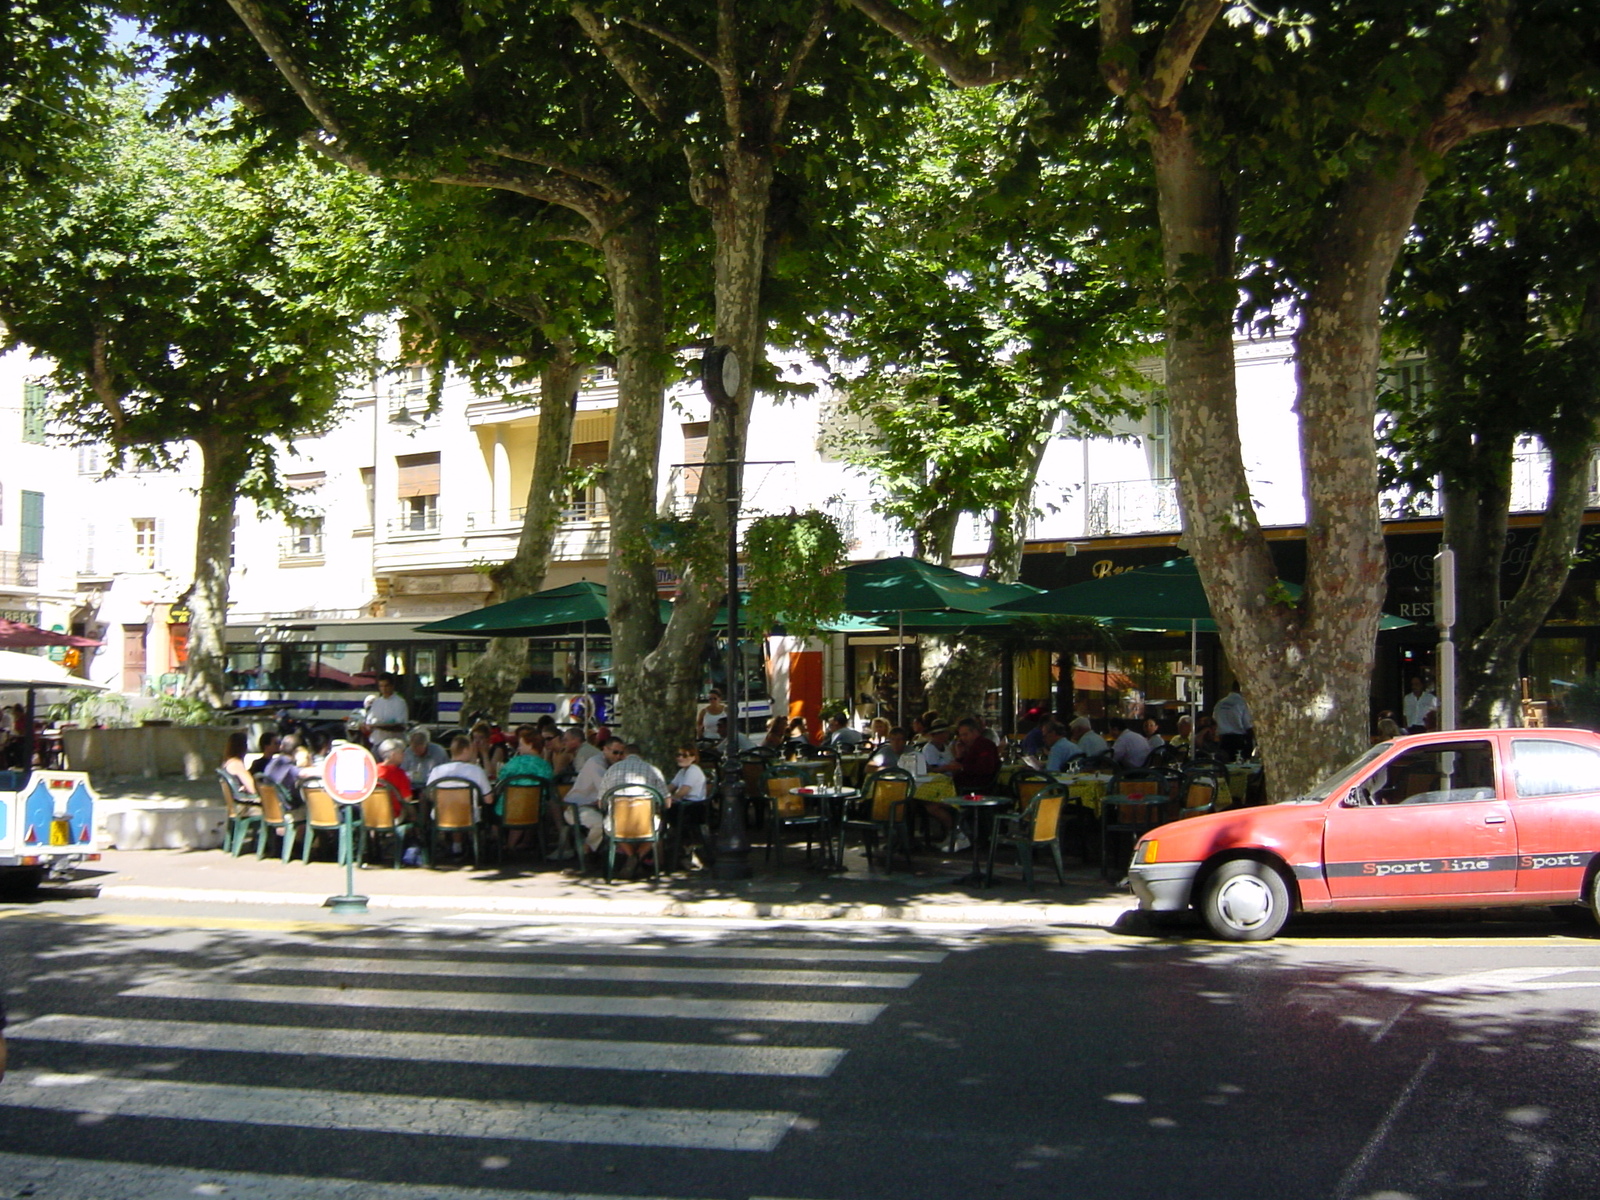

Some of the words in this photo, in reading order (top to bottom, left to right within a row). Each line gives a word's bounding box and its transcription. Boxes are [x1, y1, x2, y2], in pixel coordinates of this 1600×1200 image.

[1363, 861, 1432, 876] Sport
[1441, 859, 1490, 872] line
[1521, 853, 1582, 870] Sport
